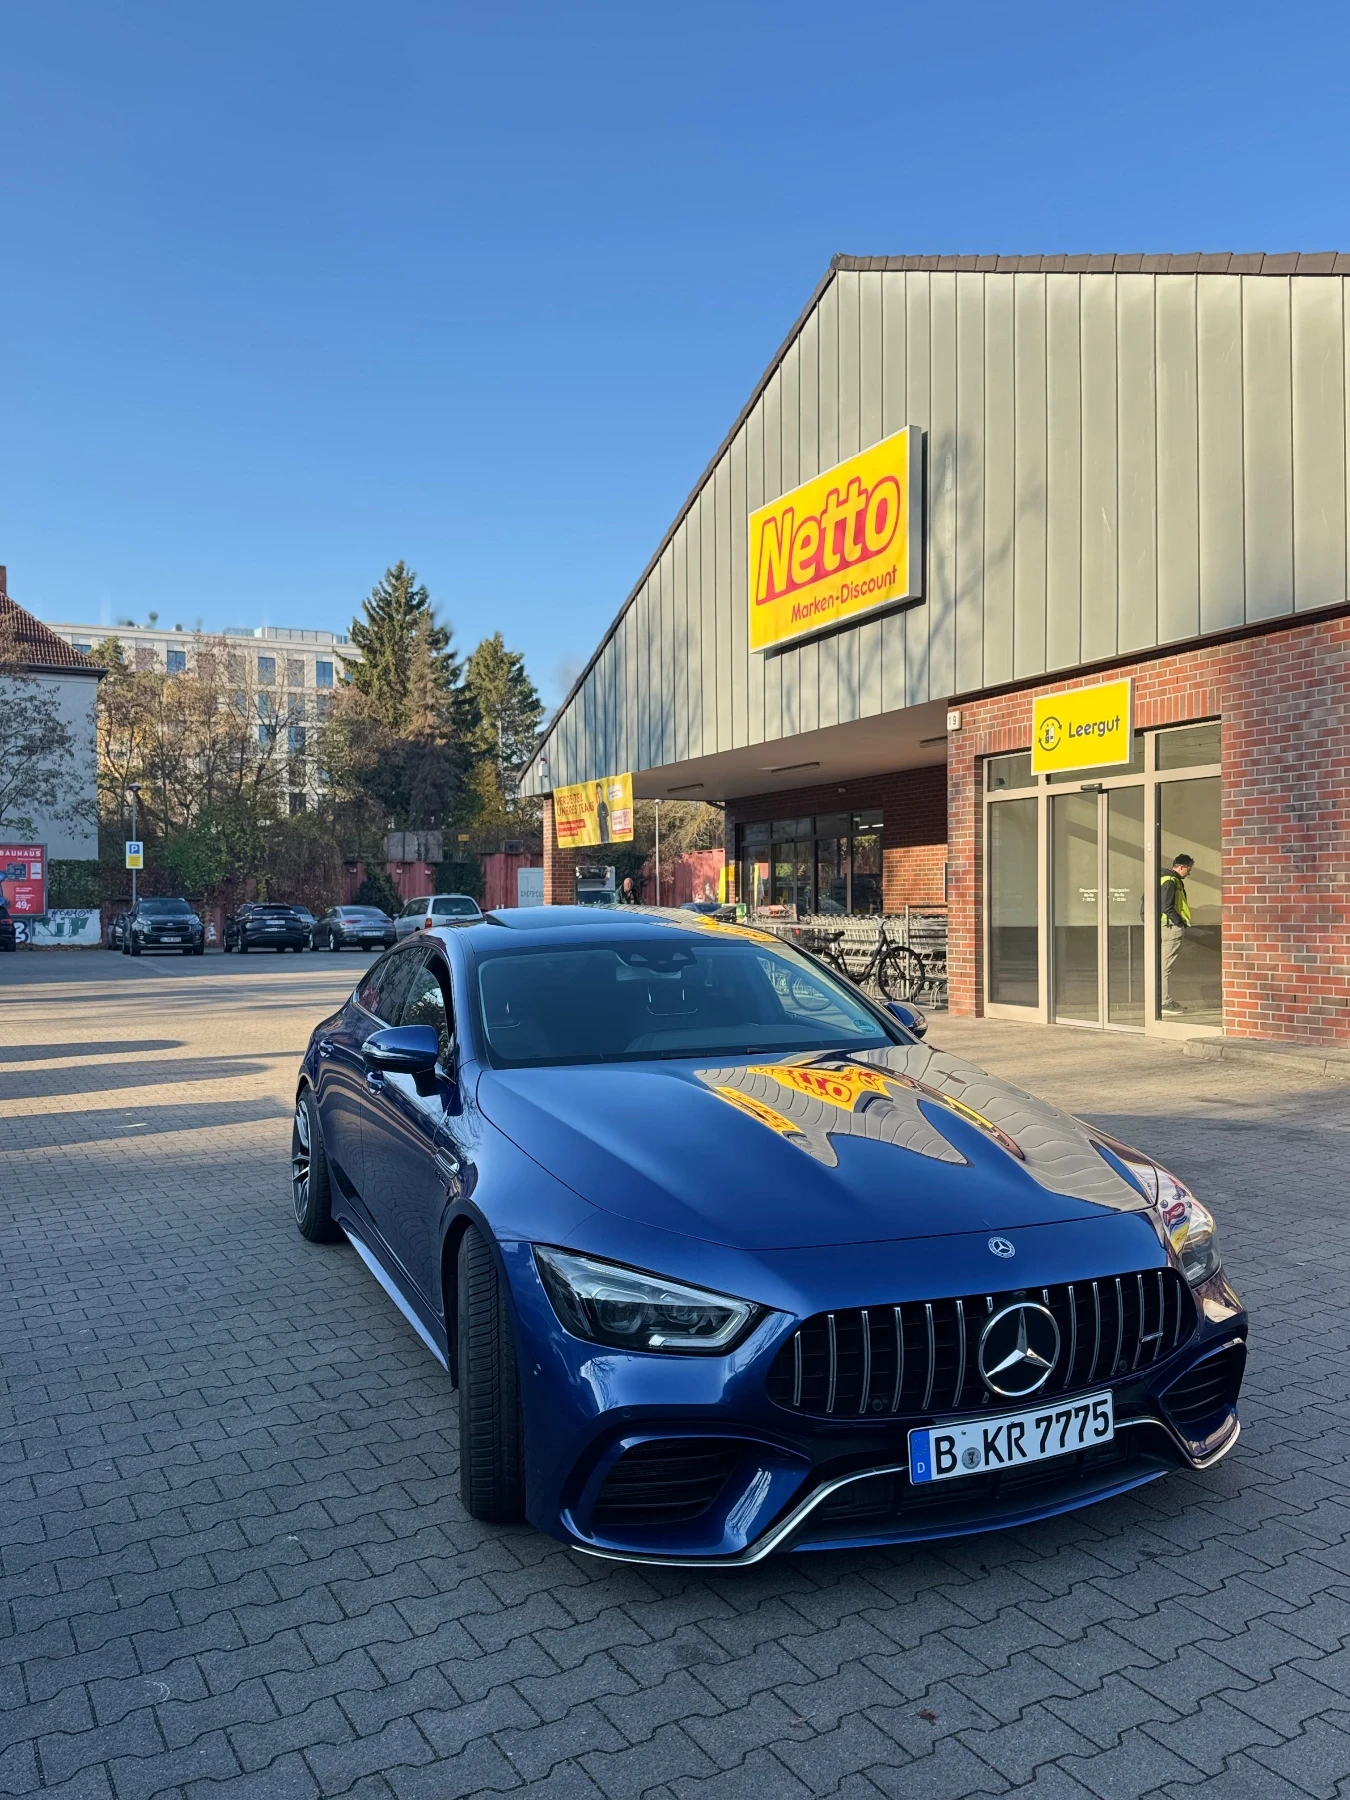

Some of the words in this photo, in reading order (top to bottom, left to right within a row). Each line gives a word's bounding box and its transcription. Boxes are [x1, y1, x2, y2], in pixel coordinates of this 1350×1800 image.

[756, 475, 900, 606] Netto
[791, 564, 898, 623] Marken-Discount
[1069, 715, 1120, 738] Leergut
[131, 845, 138, 853] P
[935, 1436, 957, 1475] B
[983, 1421, 1028, 1466] KR
[1035, 1399, 1110, 1453] 7775
[917, 1462, 925, 1473] D
